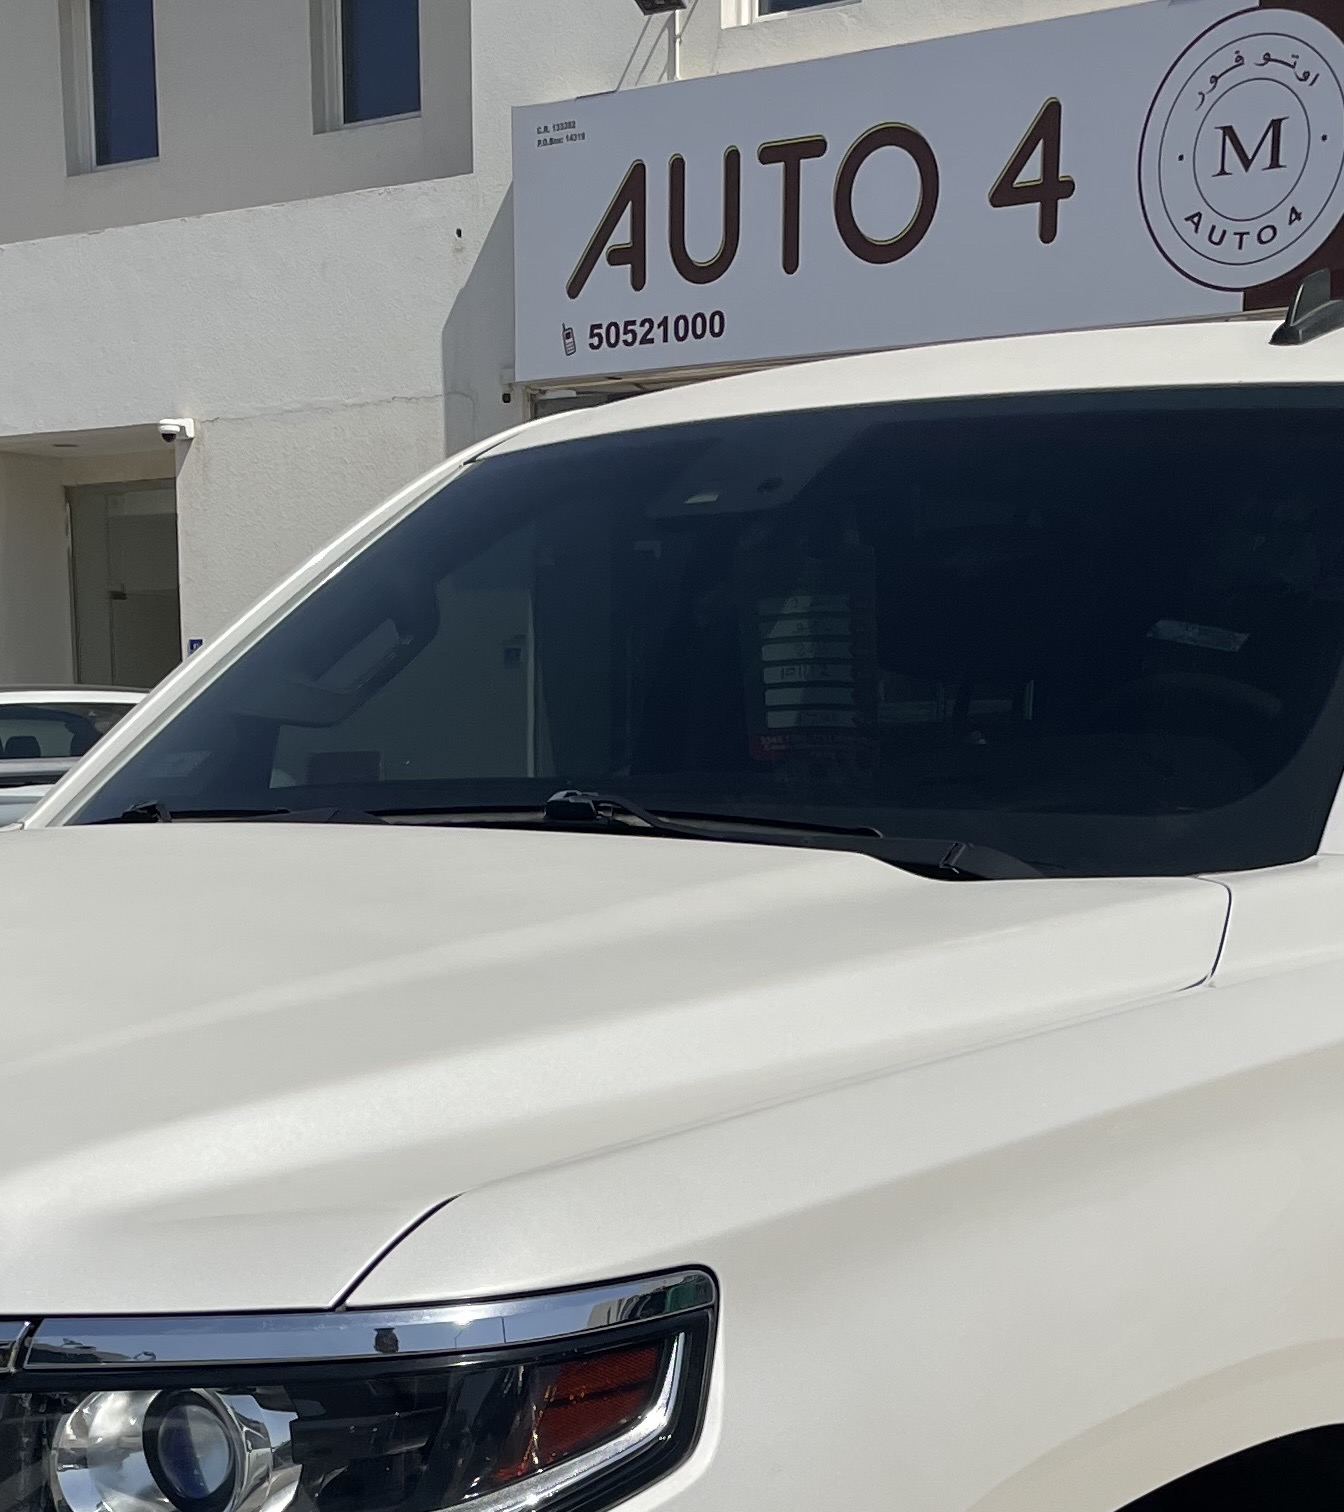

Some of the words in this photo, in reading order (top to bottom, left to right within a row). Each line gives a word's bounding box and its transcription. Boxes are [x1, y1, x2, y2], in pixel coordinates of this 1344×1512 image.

[1212, 116, 1290, 178] M
[565, 121, 940, 299] AUTO
[987, 96, 1076, 245] 4
[1184, 210, 1279, 251] AUTO
[1287, 205, 1303, 226] 4
[586, 309, 726, 351] 50521000
